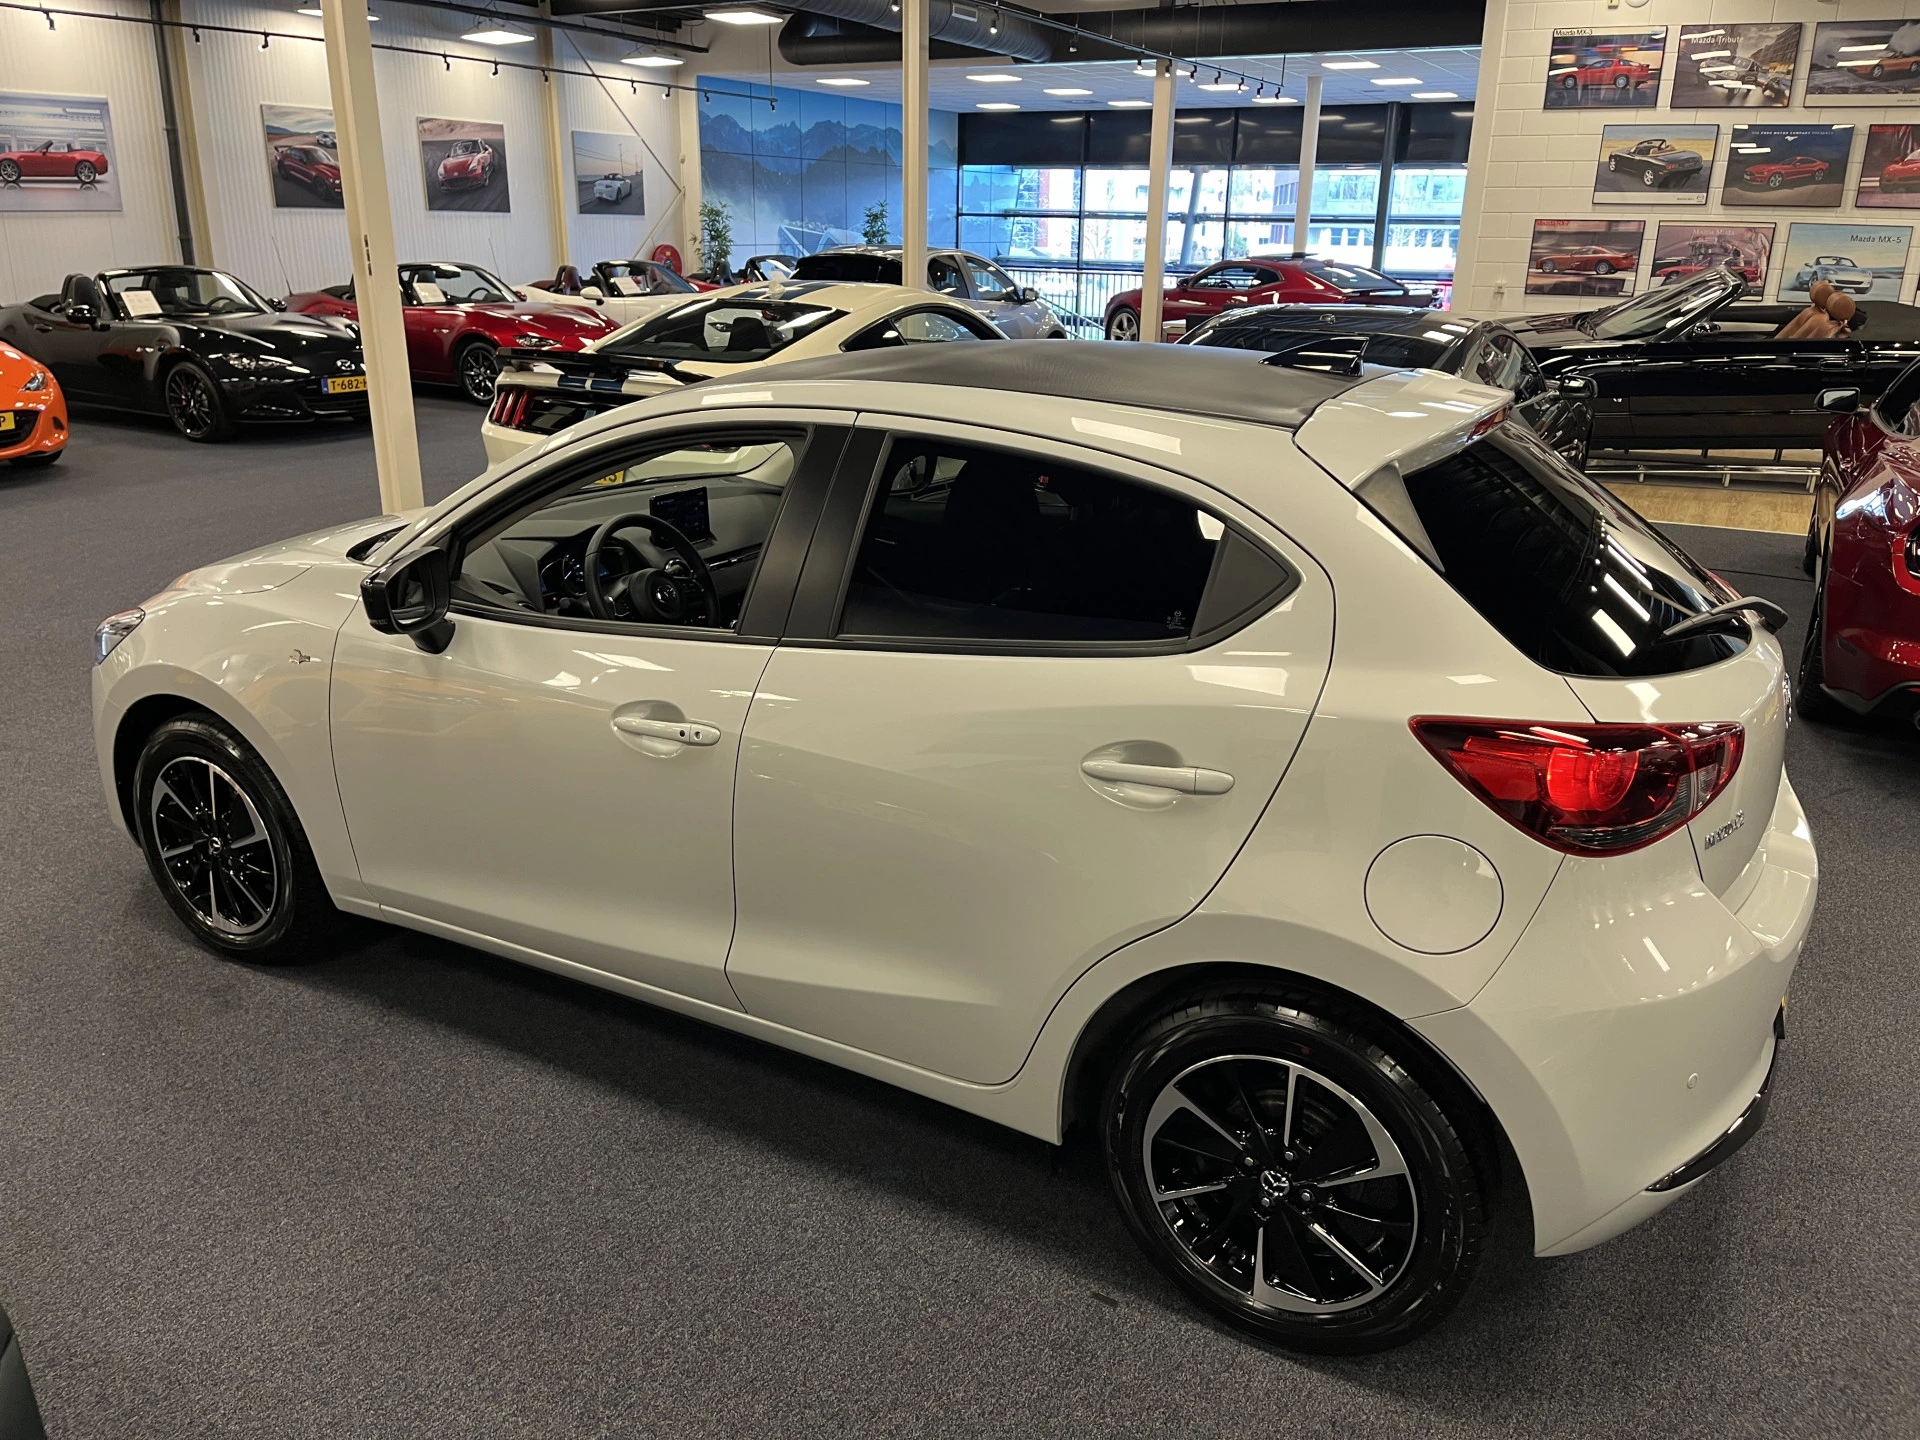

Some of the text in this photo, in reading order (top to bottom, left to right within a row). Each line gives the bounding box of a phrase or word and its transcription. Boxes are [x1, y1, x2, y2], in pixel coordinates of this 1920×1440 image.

[1576, 28, 1593, 36] MX-3
[1691, 35, 1743, 45] Mazda Tribute
[1850, 234, 1902, 244] Mazda MX-5
